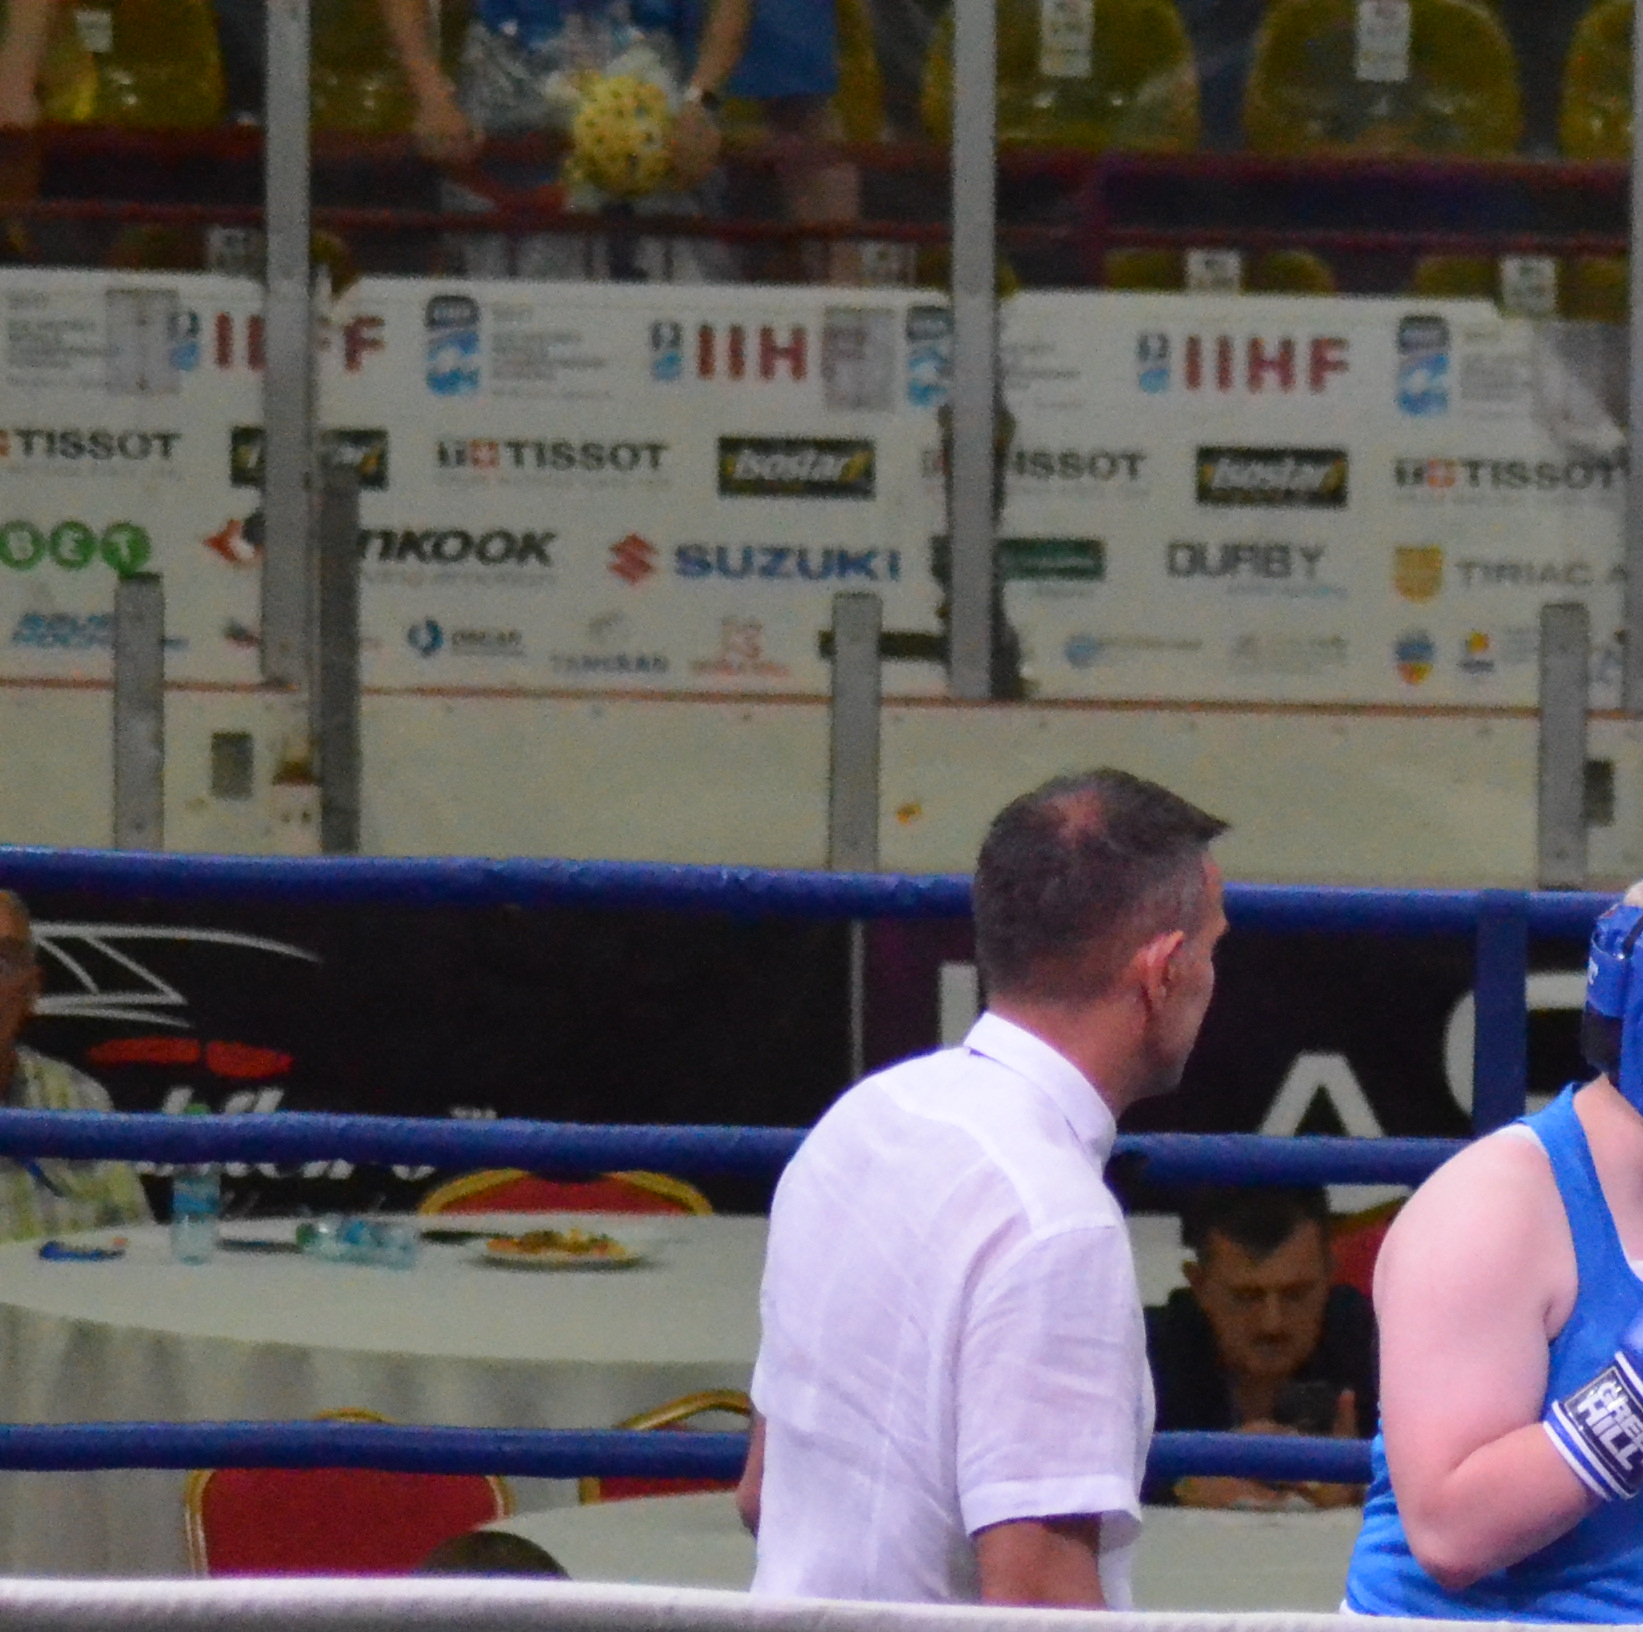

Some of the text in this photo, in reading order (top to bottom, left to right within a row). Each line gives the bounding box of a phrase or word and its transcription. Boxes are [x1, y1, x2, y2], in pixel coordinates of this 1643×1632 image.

[1183, 334, 1352, 395] IIHF
[16, 428, 182, 462] TISSOT
[506, 440, 670, 472] TISSOT
[1010, 448, 1148, 482] ISSOT
[674, 544, 900, 581] SUZUKI
